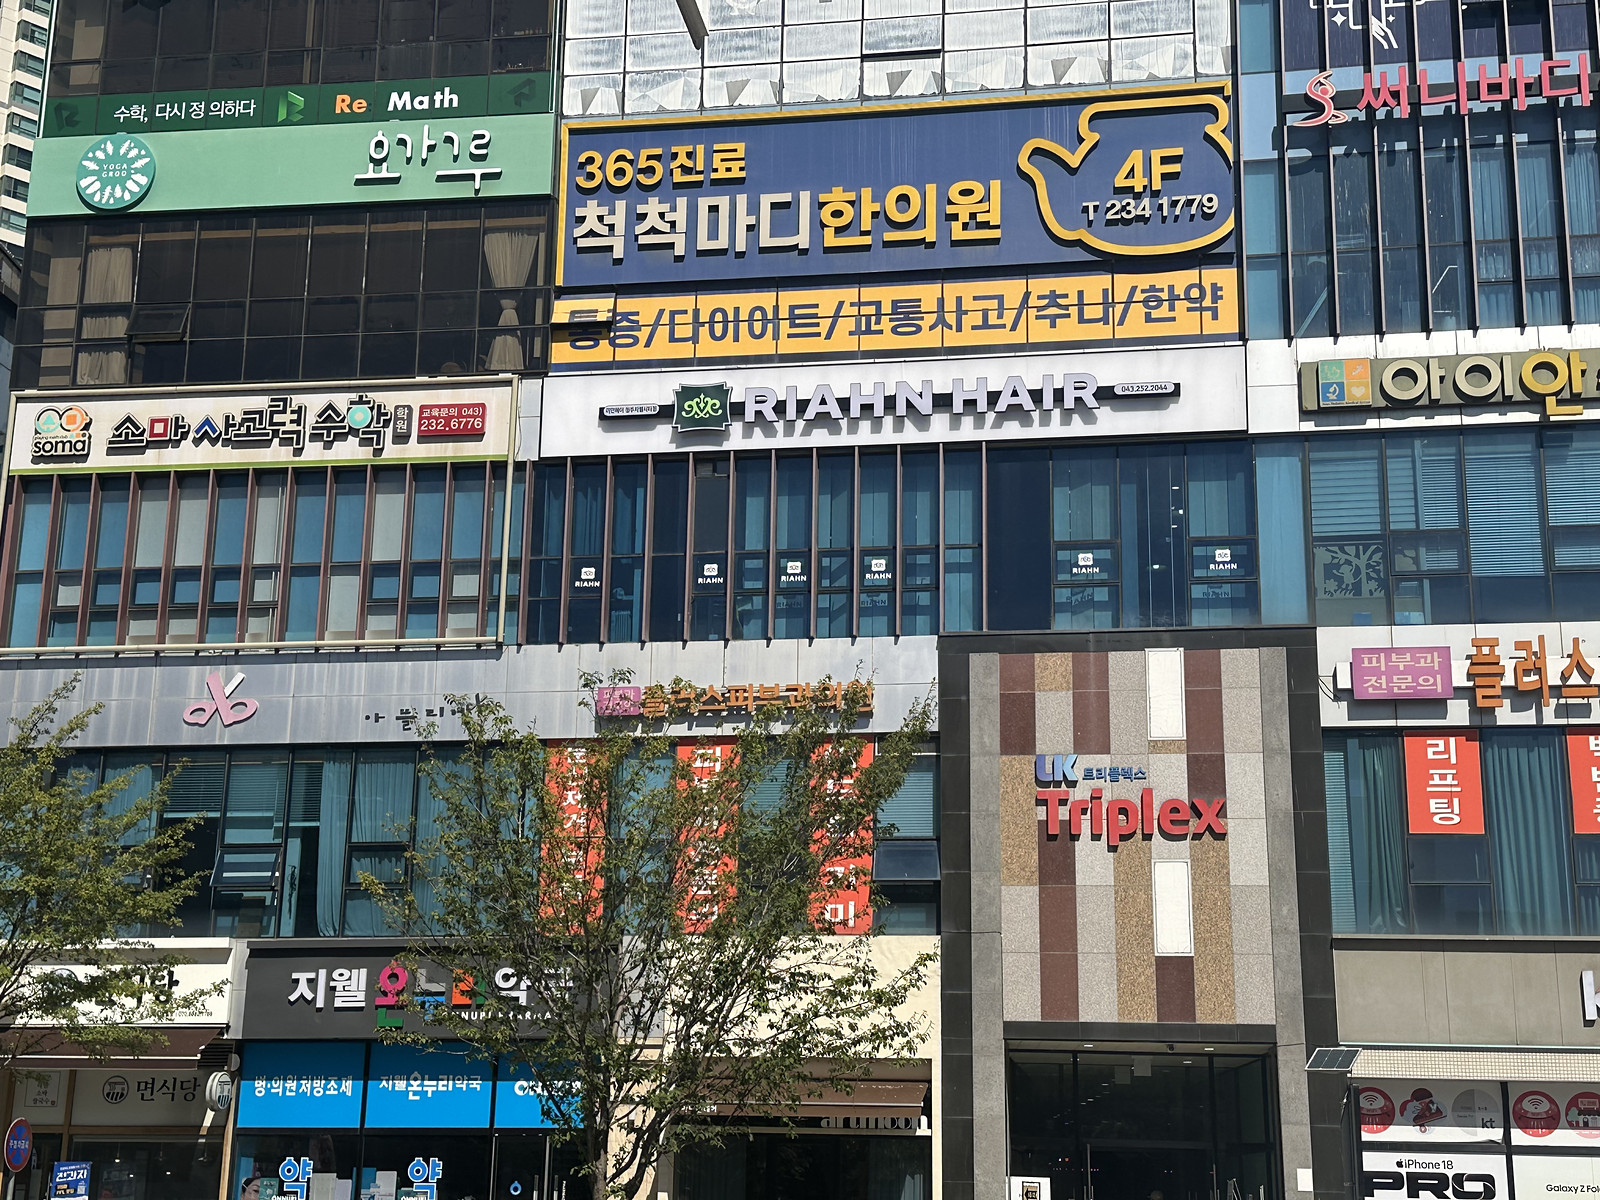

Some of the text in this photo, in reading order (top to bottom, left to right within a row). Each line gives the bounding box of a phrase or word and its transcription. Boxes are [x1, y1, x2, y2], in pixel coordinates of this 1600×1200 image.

[387, 86, 459, 112] Math
[1357, 53, 1591, 119] 써니바디
[576, 142, 747, 191] 365진료
[1114, 147, 1184, 193] 4F
[1105, 196, 1152, 220] 234
[1158, 193, 1219, 217] 1779
[1381, 350, 1588, 416] 아이안
[745, 373, 1100, 424] RIAHN HAIR
[420, 418, 483, 431] 232.6776
[421, 407, 483, 418] 교육문의 043)
[33, 440, 87, 454] soma
[1072, 566, 1100, 574] RIAHN
[574, 580, 601, 588] RIAHN
[1360, 651, 1443, 671] 피부과
[1468, 634, 1599, 708] 플러스
[1362, 674, 1443, 694] 전문의
[1082, 767, 1147, 783] 트리플렉스
[1426, 737, 1462, 826] 리프팅
[1036, 787, 1228, 846] Triplex
[136, 1076, 200, 1102] 면식당
[299, 1074, 353, 1097] 처방조제
[379, 1071, 483, 1100] 지웰온누리약국
[1481, 1117, 1496, 1129] kt
[279, 1157, 314, 1200] 약
[408, 1157, 443, 1200] 약
[1404, 1161, 1454, 1170] iPhone 18
[1362, 1172, 1497, 1200] PRO
[1545, 1184, 1579, 1194] Galaxy
[1580, 1184, 1586, 1193] Z
